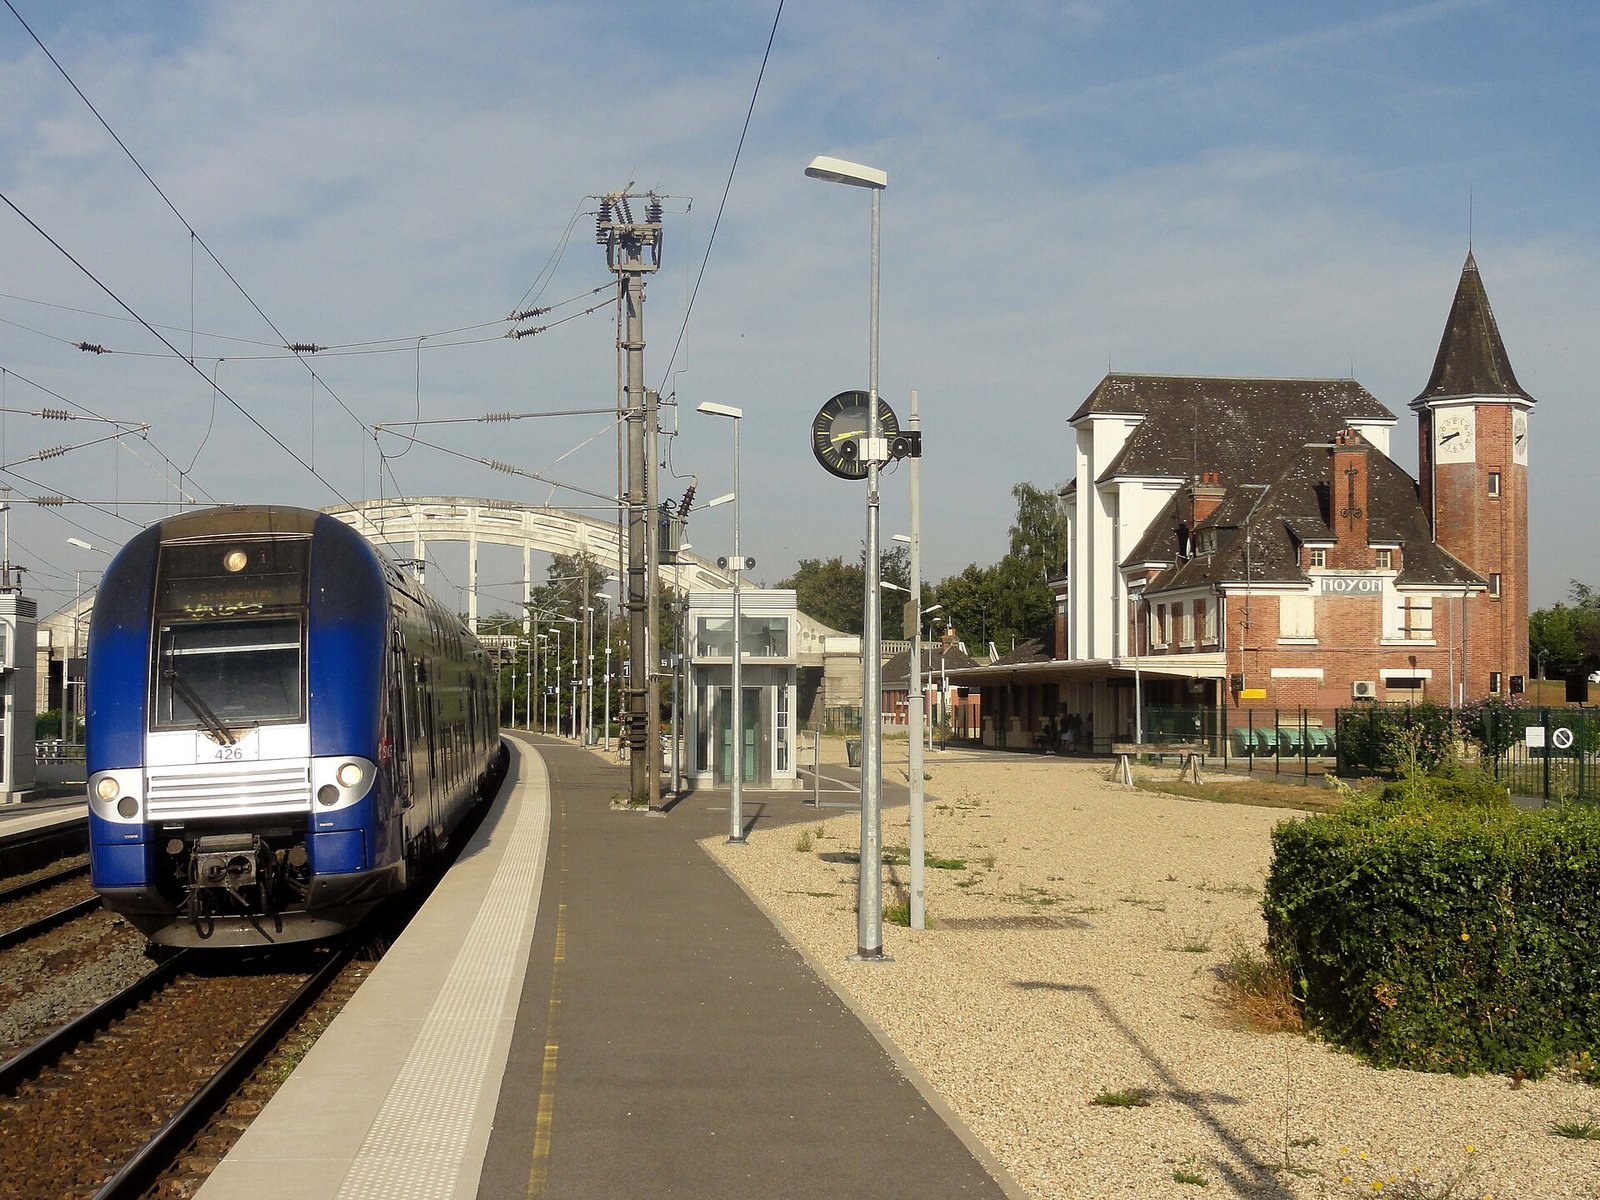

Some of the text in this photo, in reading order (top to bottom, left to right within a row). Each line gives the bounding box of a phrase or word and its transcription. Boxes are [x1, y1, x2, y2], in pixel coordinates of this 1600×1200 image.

[1322, 579, 1382, 592] NOYON
[623, 665, 629, 676] 1
[215, 748, 242, 760] 426
